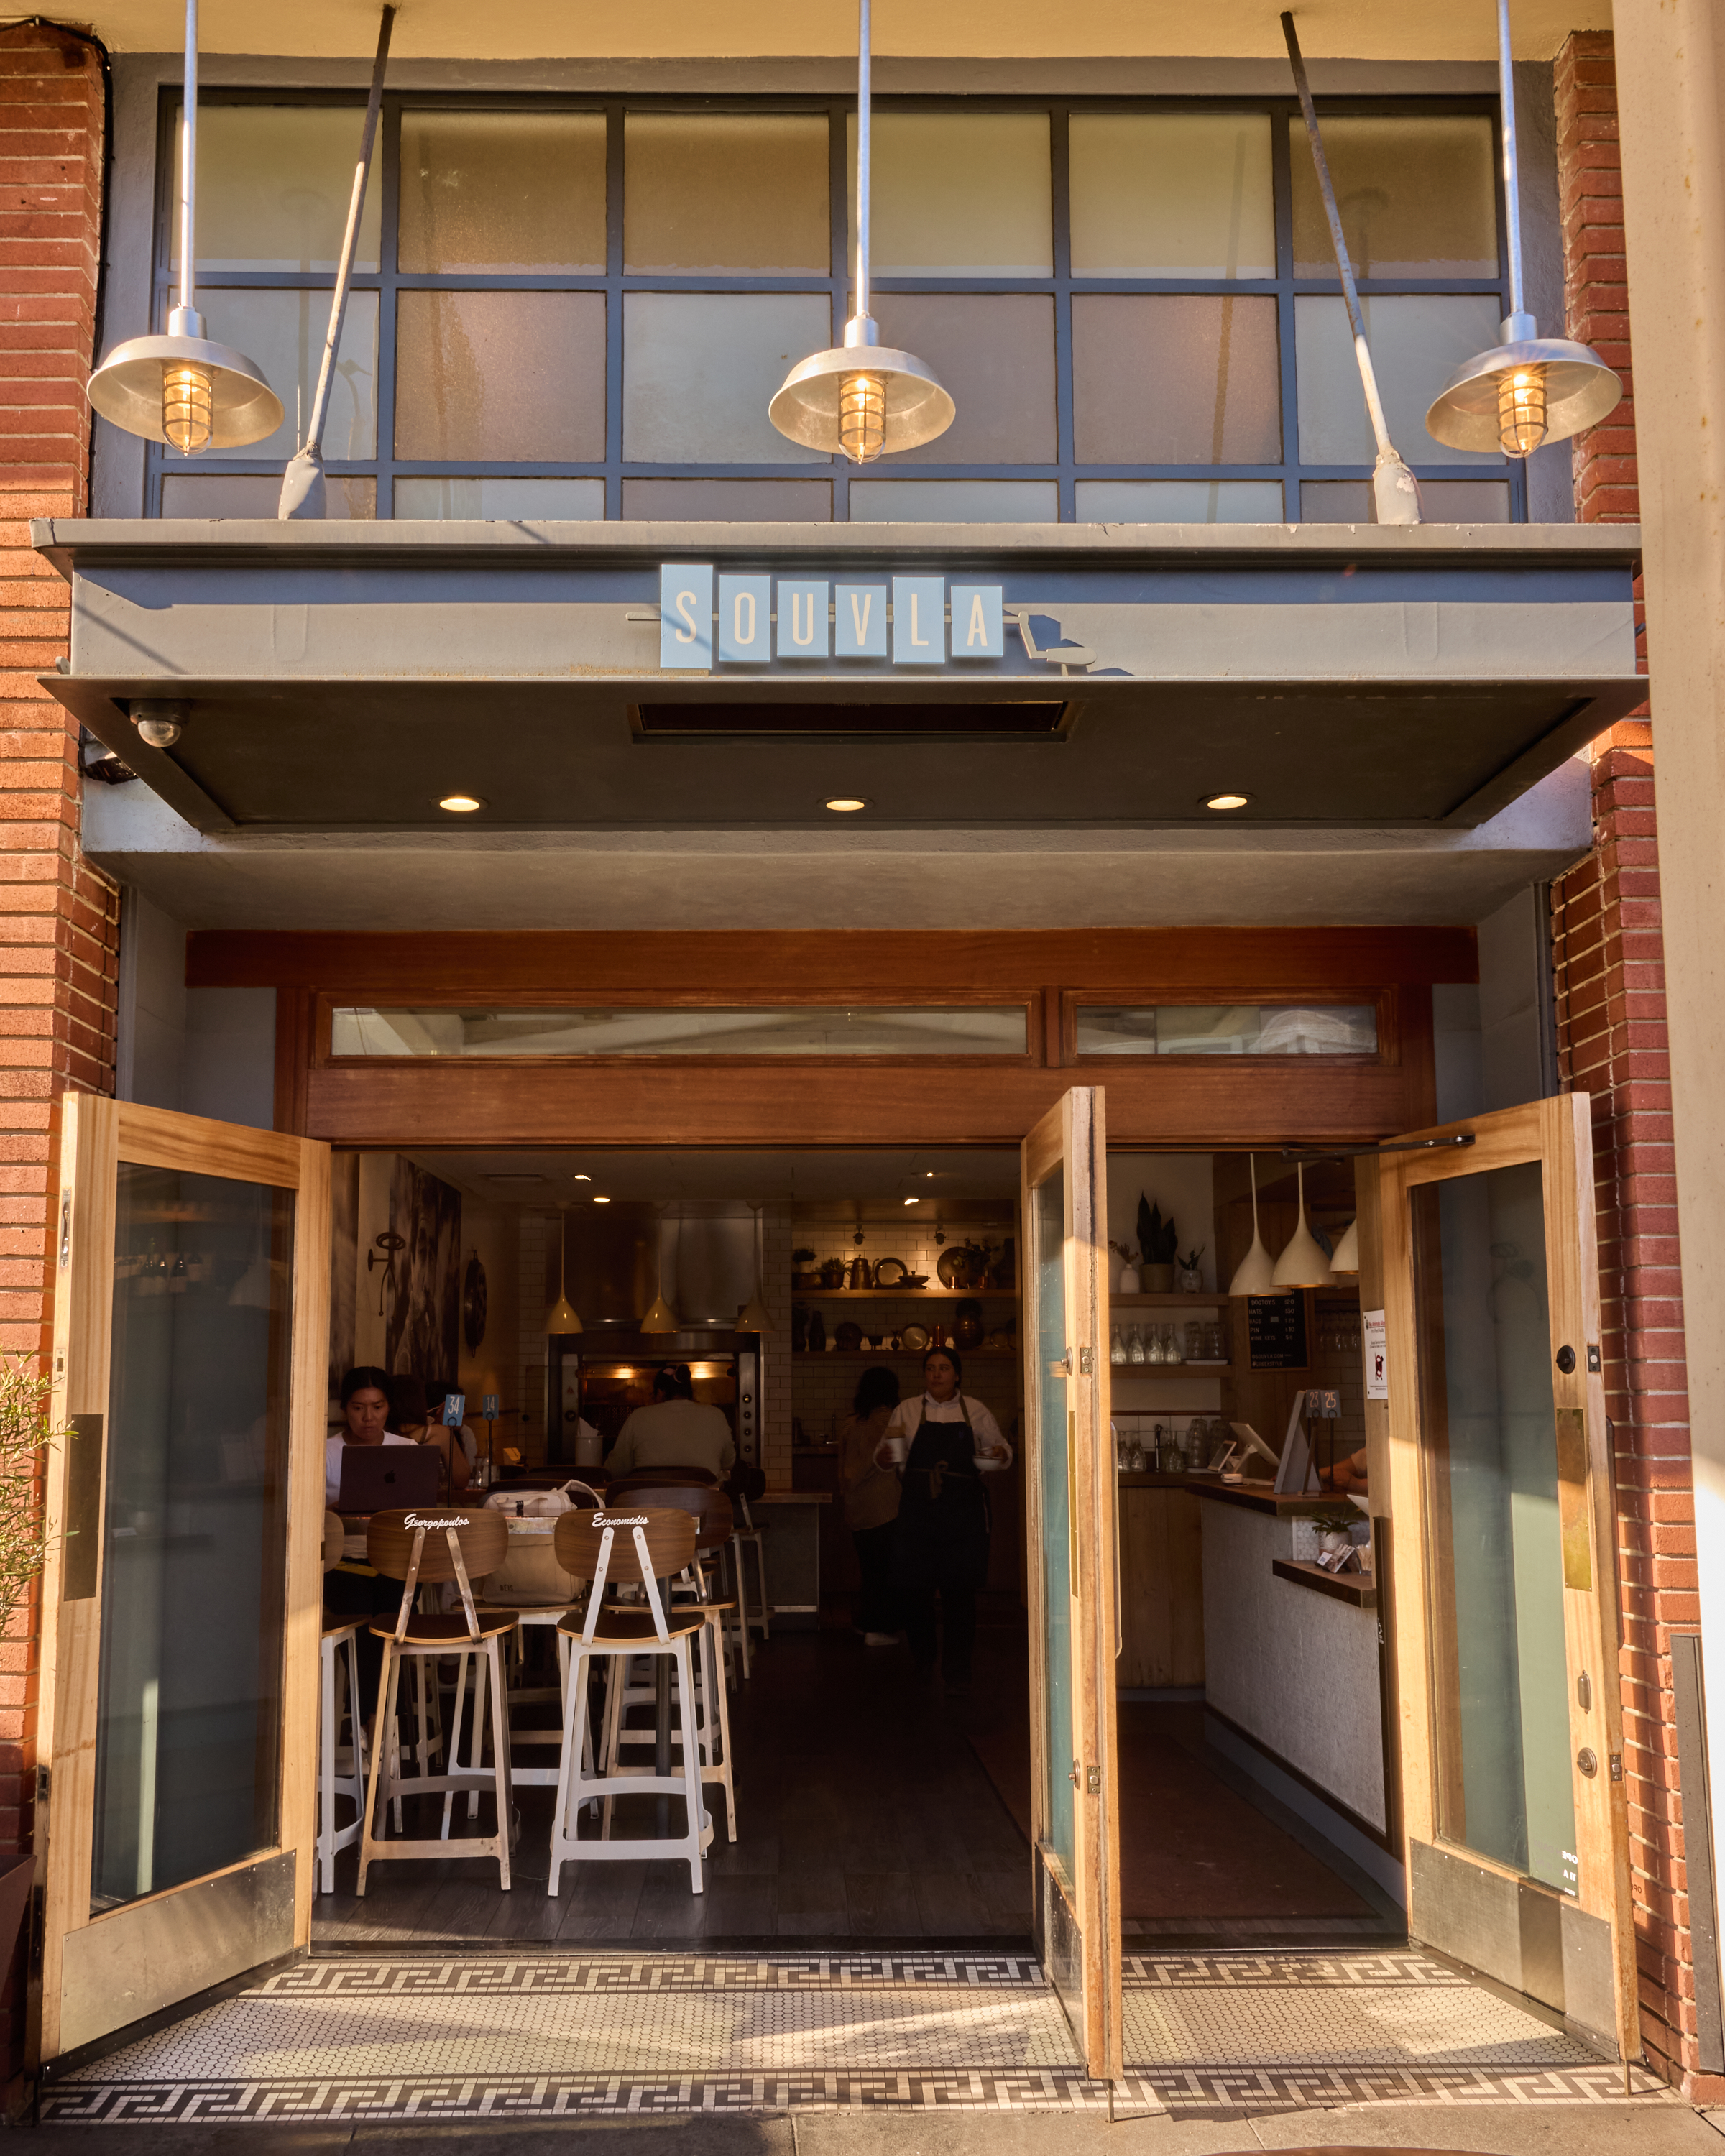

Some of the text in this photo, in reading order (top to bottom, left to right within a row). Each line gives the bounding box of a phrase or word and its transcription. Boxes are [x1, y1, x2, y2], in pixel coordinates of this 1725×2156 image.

[676, 591, 988, 647] SOUVLA
[448, 1396, 460, 1414] 34
[486, 1396, 495, 1411] 14
[1310, 1391, 1319, 1408] 23
[1325, 1391, 1337, 1409] 25
[404, 1513, 469, 1530] Georgopoulos
[592, 1512, 649, 1527] Economidis
